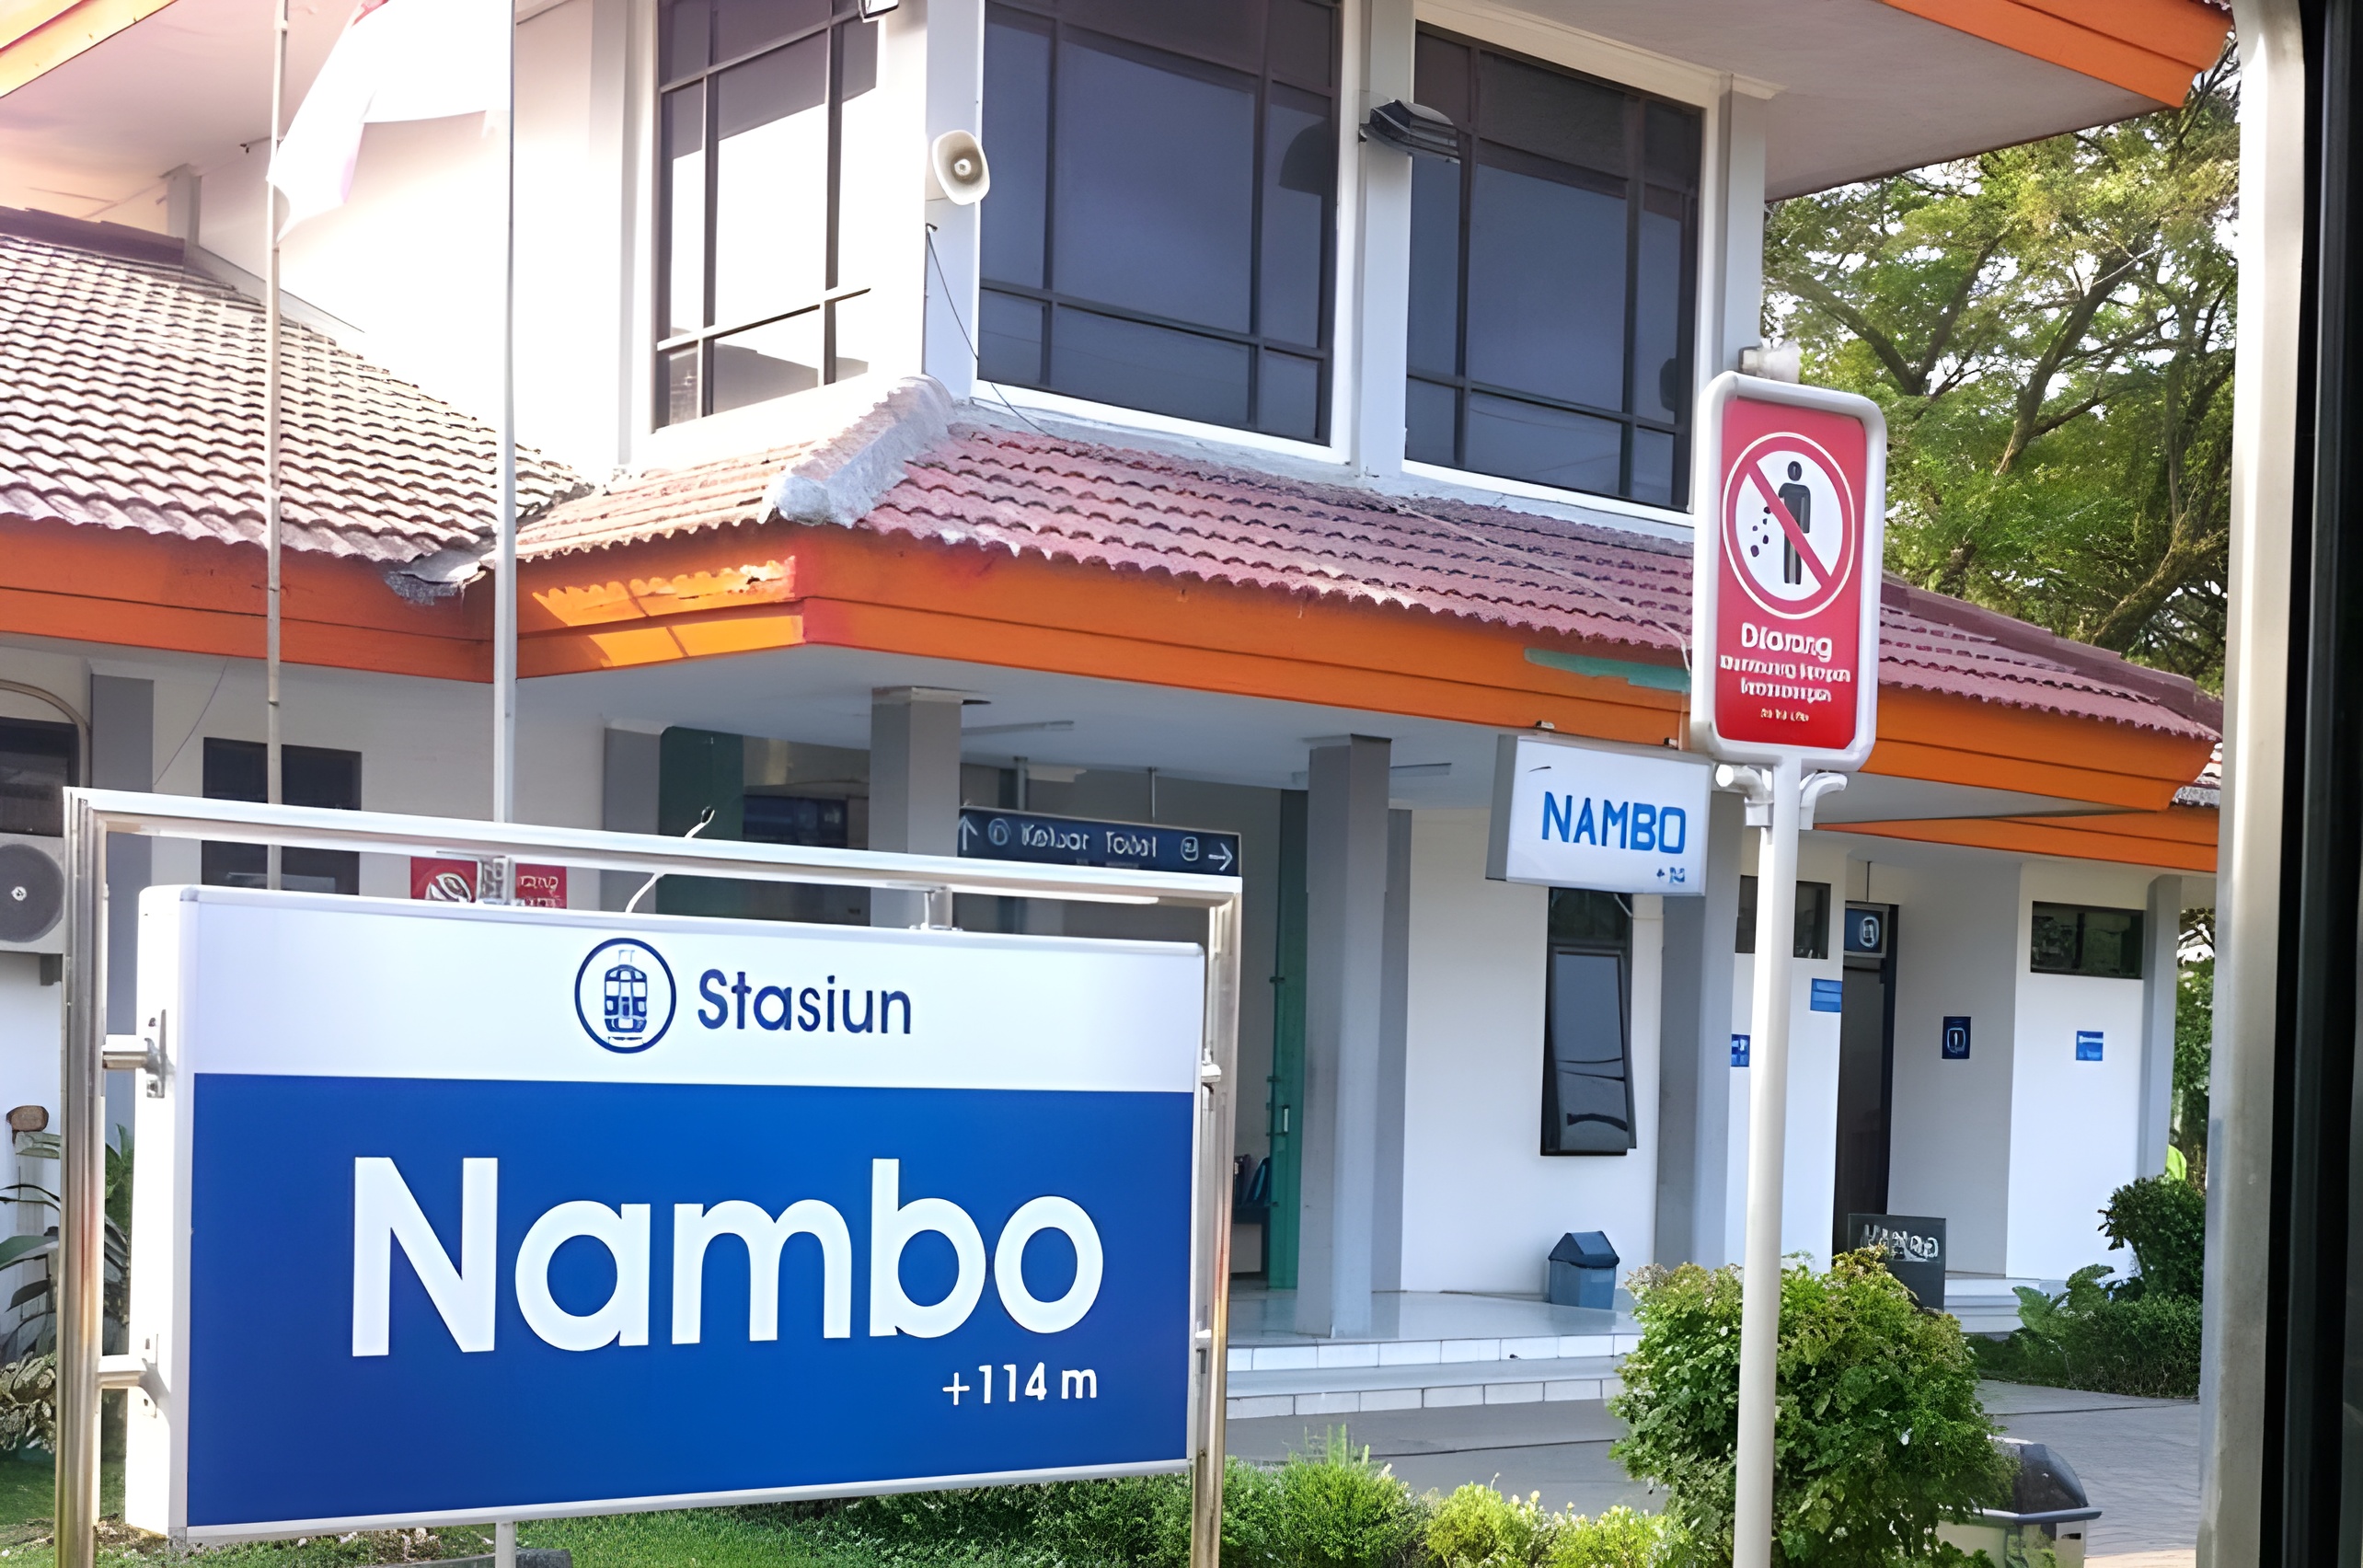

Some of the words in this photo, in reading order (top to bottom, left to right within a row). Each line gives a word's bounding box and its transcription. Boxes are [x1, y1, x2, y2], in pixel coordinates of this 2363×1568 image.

[1541, 790, 1687, 855] NAMBO
[697, 968, 911, 1035] Stasiun
[352, 1157, 1104, 1357] Nambo
[942, 1361, 1047, 1406] +114
[1061, 1368, 1098, 1400] m
